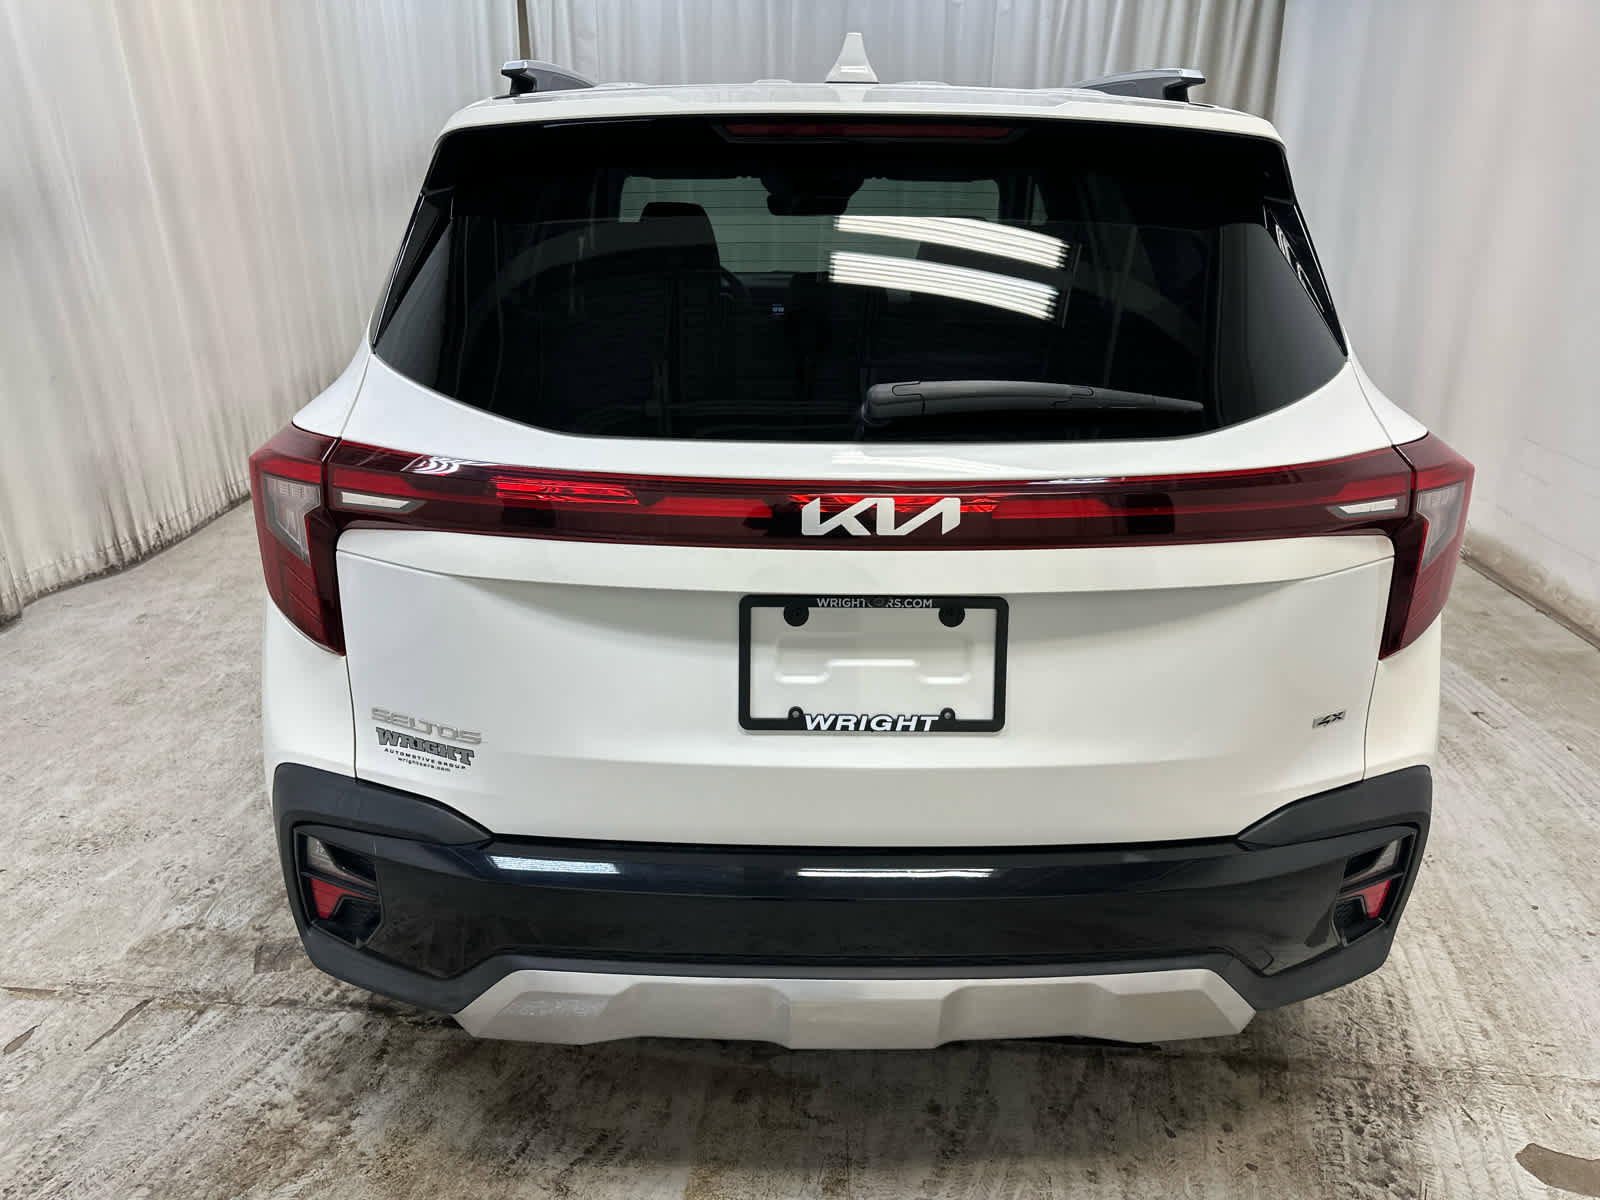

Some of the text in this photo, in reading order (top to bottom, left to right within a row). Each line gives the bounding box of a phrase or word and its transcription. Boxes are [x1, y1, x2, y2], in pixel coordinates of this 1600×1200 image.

[817, 598, 932, 608] WRIGHTRS.COM
[371, 707, 482, 745] SELTOS
[805, 714, 939, 732] WRIGHT
[375, 726, 475, 766] WRIGHT
[384, 748, 466, 769] AUTOMOTIVE GROUP
